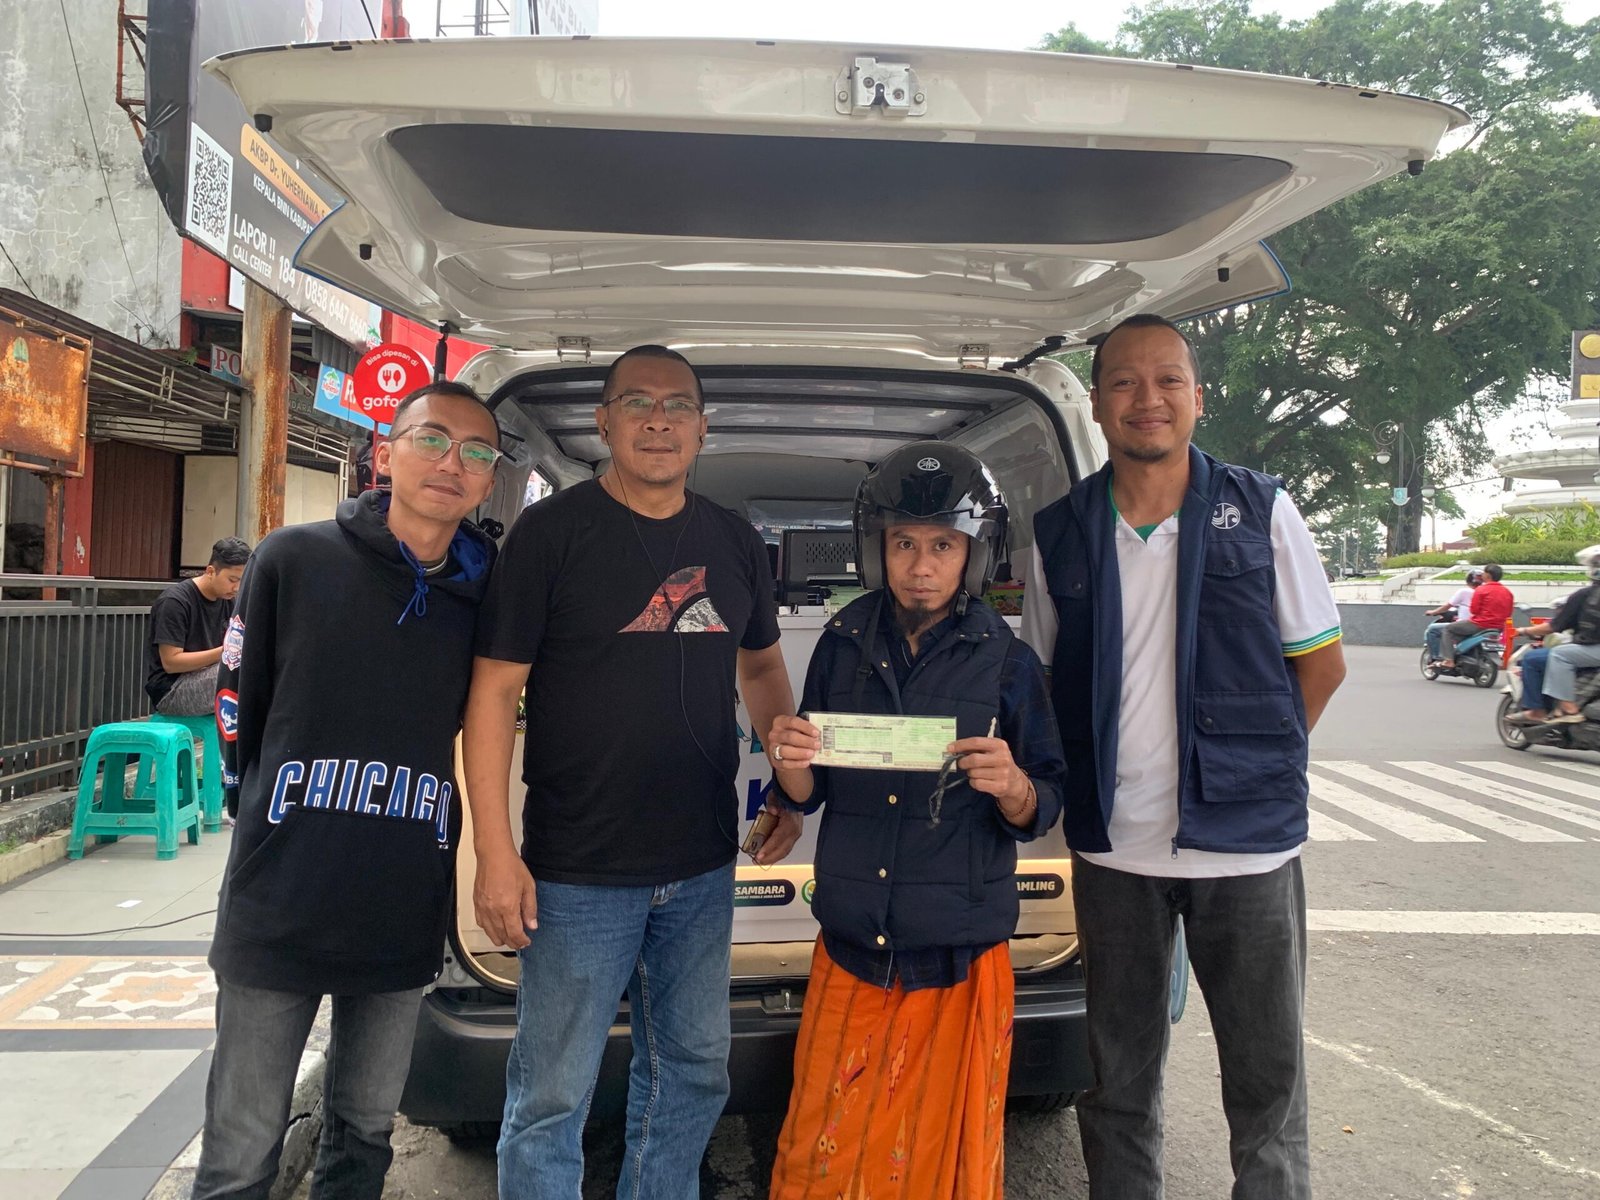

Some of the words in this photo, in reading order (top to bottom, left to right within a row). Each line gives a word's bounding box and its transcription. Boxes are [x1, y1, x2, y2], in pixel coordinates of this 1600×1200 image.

[249, 139, 269, 166] AKBP
[269, 157, 280, 179] Dr.
[253, 173, 277, 207] KEPALA
[276, 195, 290, 219] BNN
[233, 213, 267, 255] LAPOR
[269, 237, 277, 260] !!
[232, 244, 249, 265] CALL
[250, 255, 273, 279] CENTER
[279, 255, 295, 288] 184
[296, 271, 305, 295] /
[305, 275, 328, 312] 0858
[329, 295, 350, 326] 6447
[214, 347, 242, 376] PO
[366, 353, 382, 366] Bisa
[381, 349, 411, 361] dipesan
[410, 359, 419, 367] di
[362, 395, 402, 411] gofo
[267, 759, 453, 843] CHICAGO
[734, 885, 786, 896] SAMBARA
